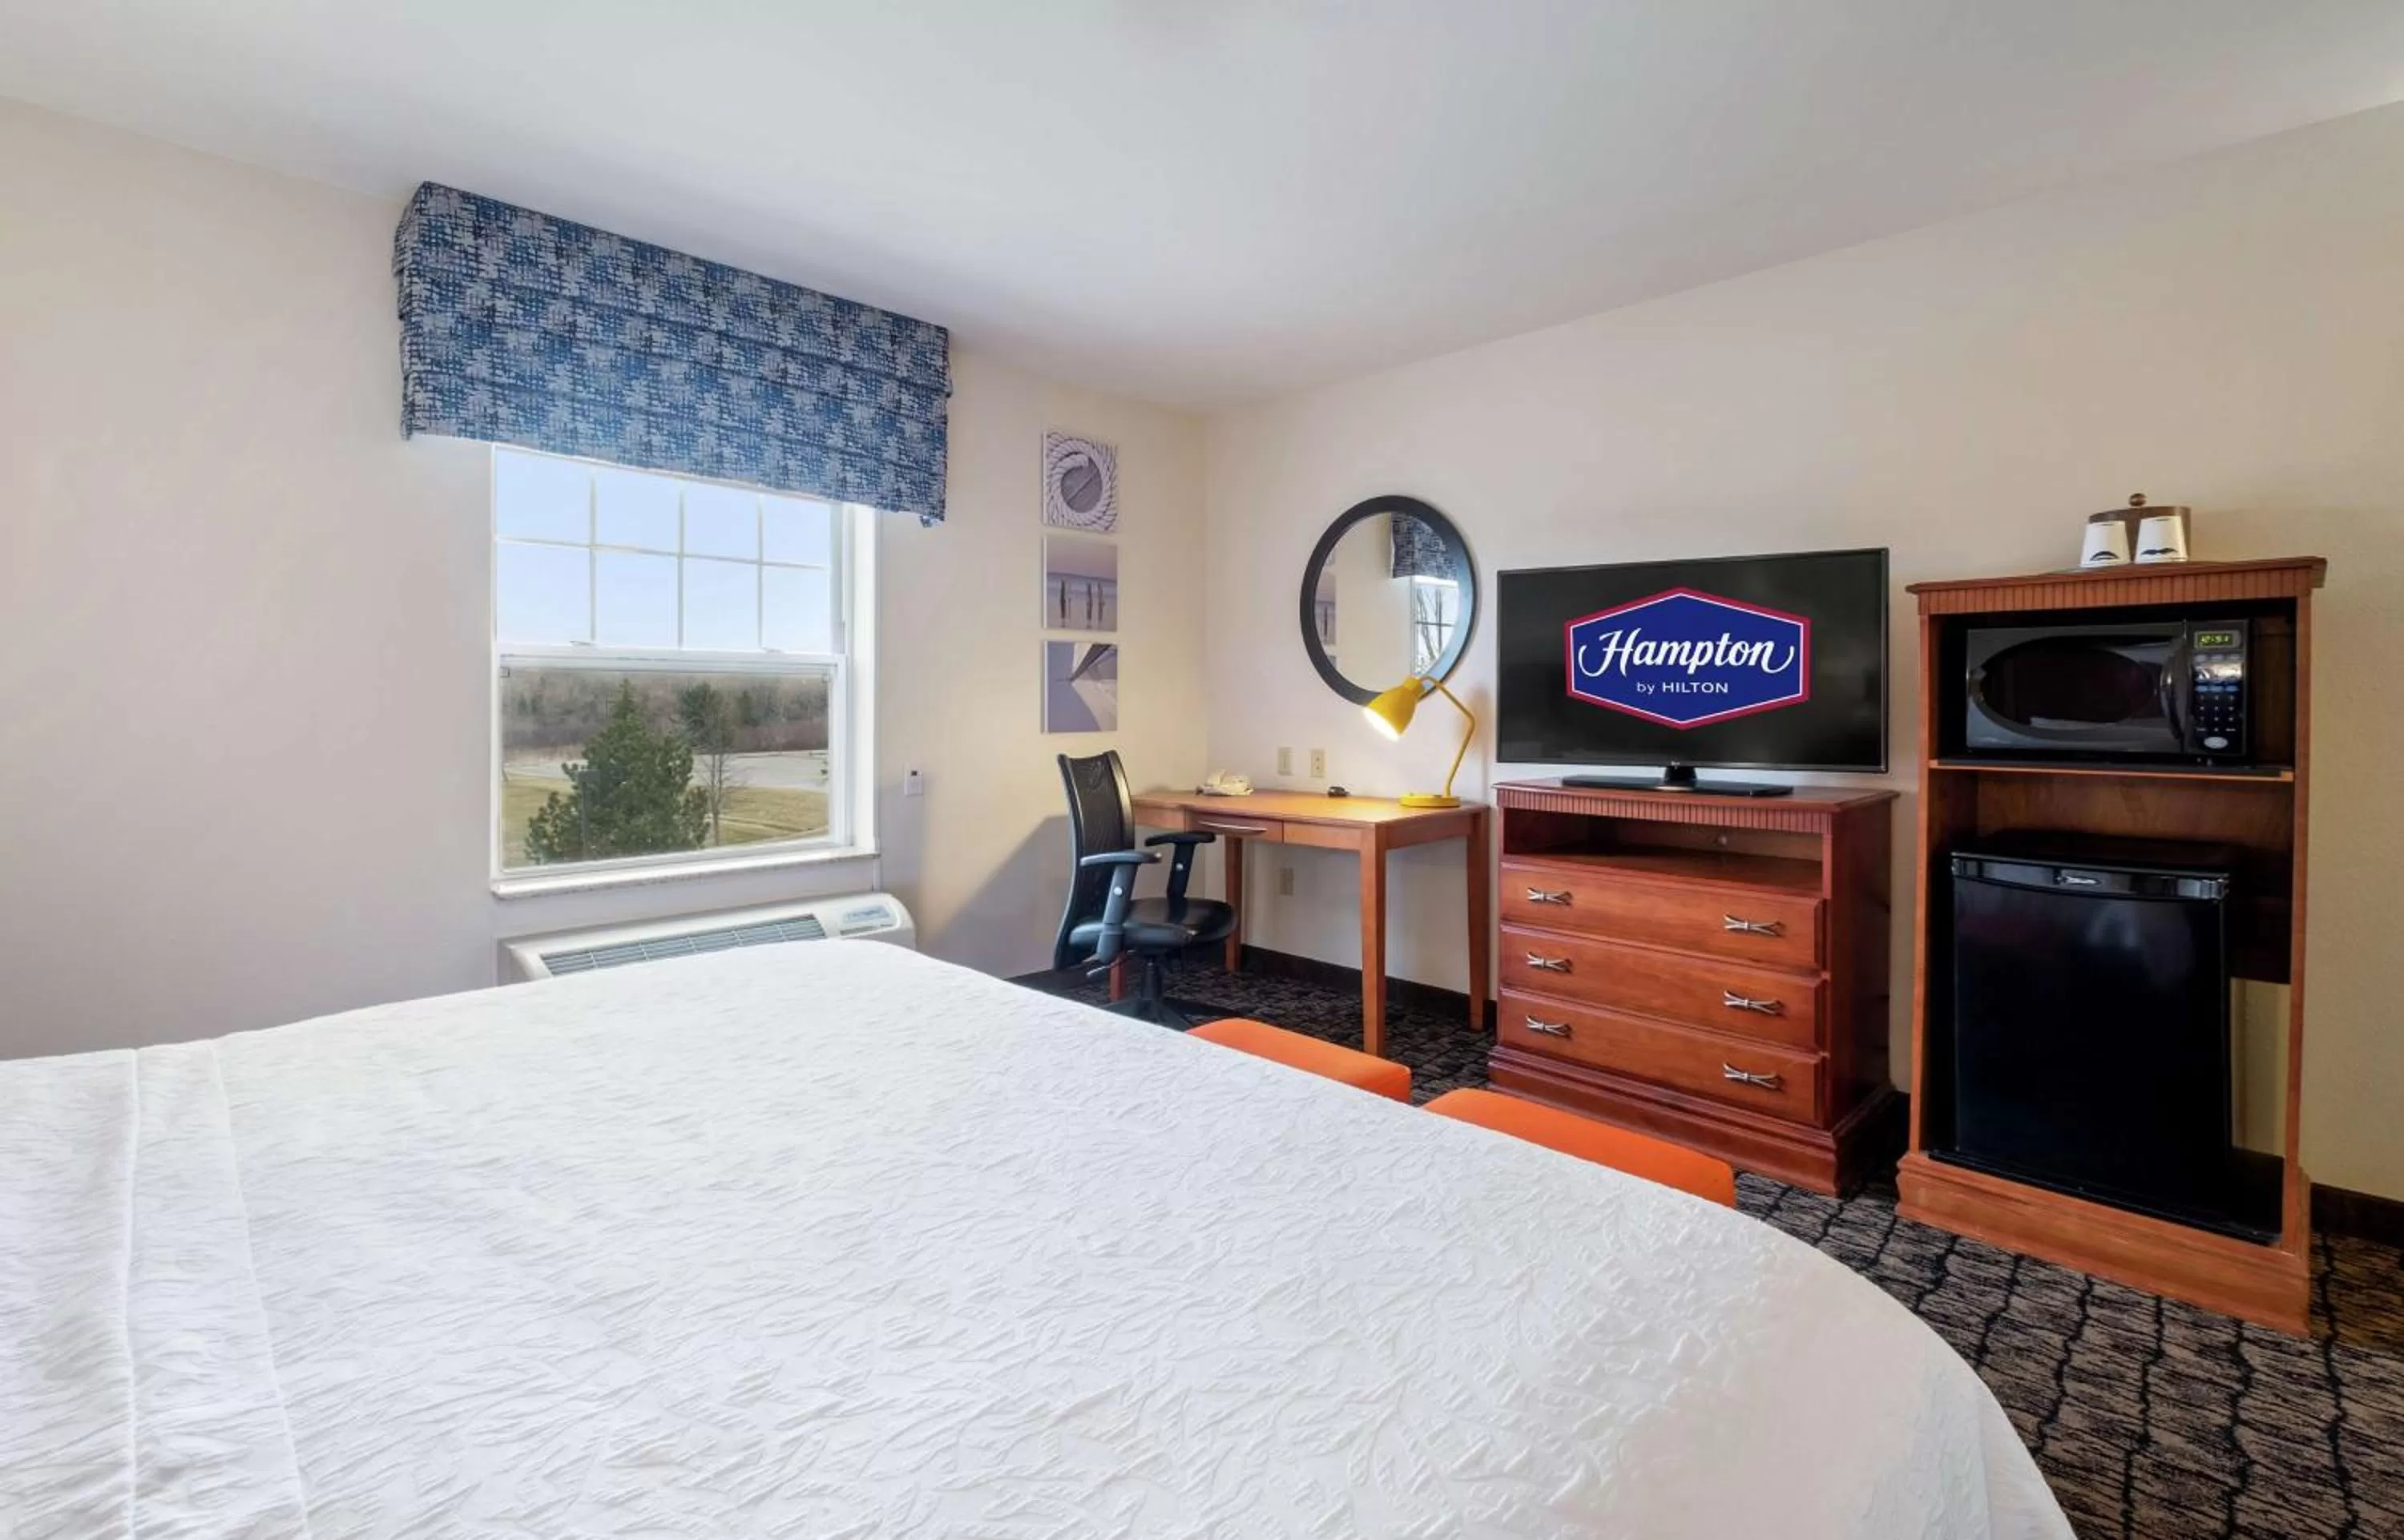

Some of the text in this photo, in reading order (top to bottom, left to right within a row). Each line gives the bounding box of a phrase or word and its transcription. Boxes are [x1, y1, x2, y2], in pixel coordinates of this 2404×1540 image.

[1578, 628, 1795, 676] Hampton
[1636, 682, 1728, 695] by HILTON
